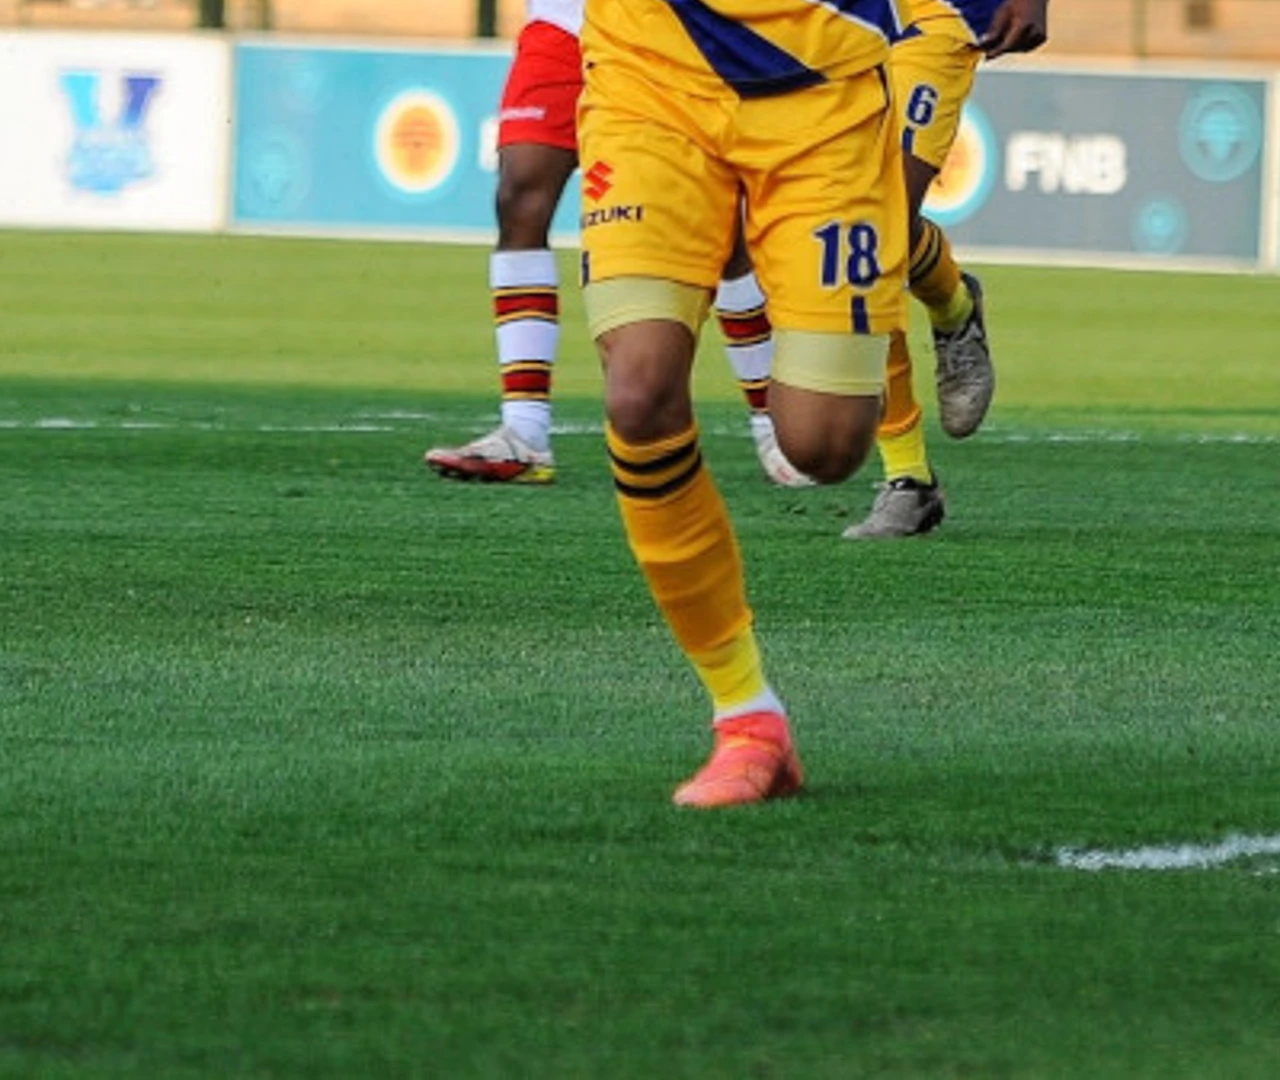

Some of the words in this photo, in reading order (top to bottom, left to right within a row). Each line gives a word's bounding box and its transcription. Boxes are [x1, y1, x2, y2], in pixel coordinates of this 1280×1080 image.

[906, 83, 939, 127] 6
[1006, 131, 1127, 195] FNB
[581, 205, 644, 229] ZUKI
[812, 220, 882, 288] 18
